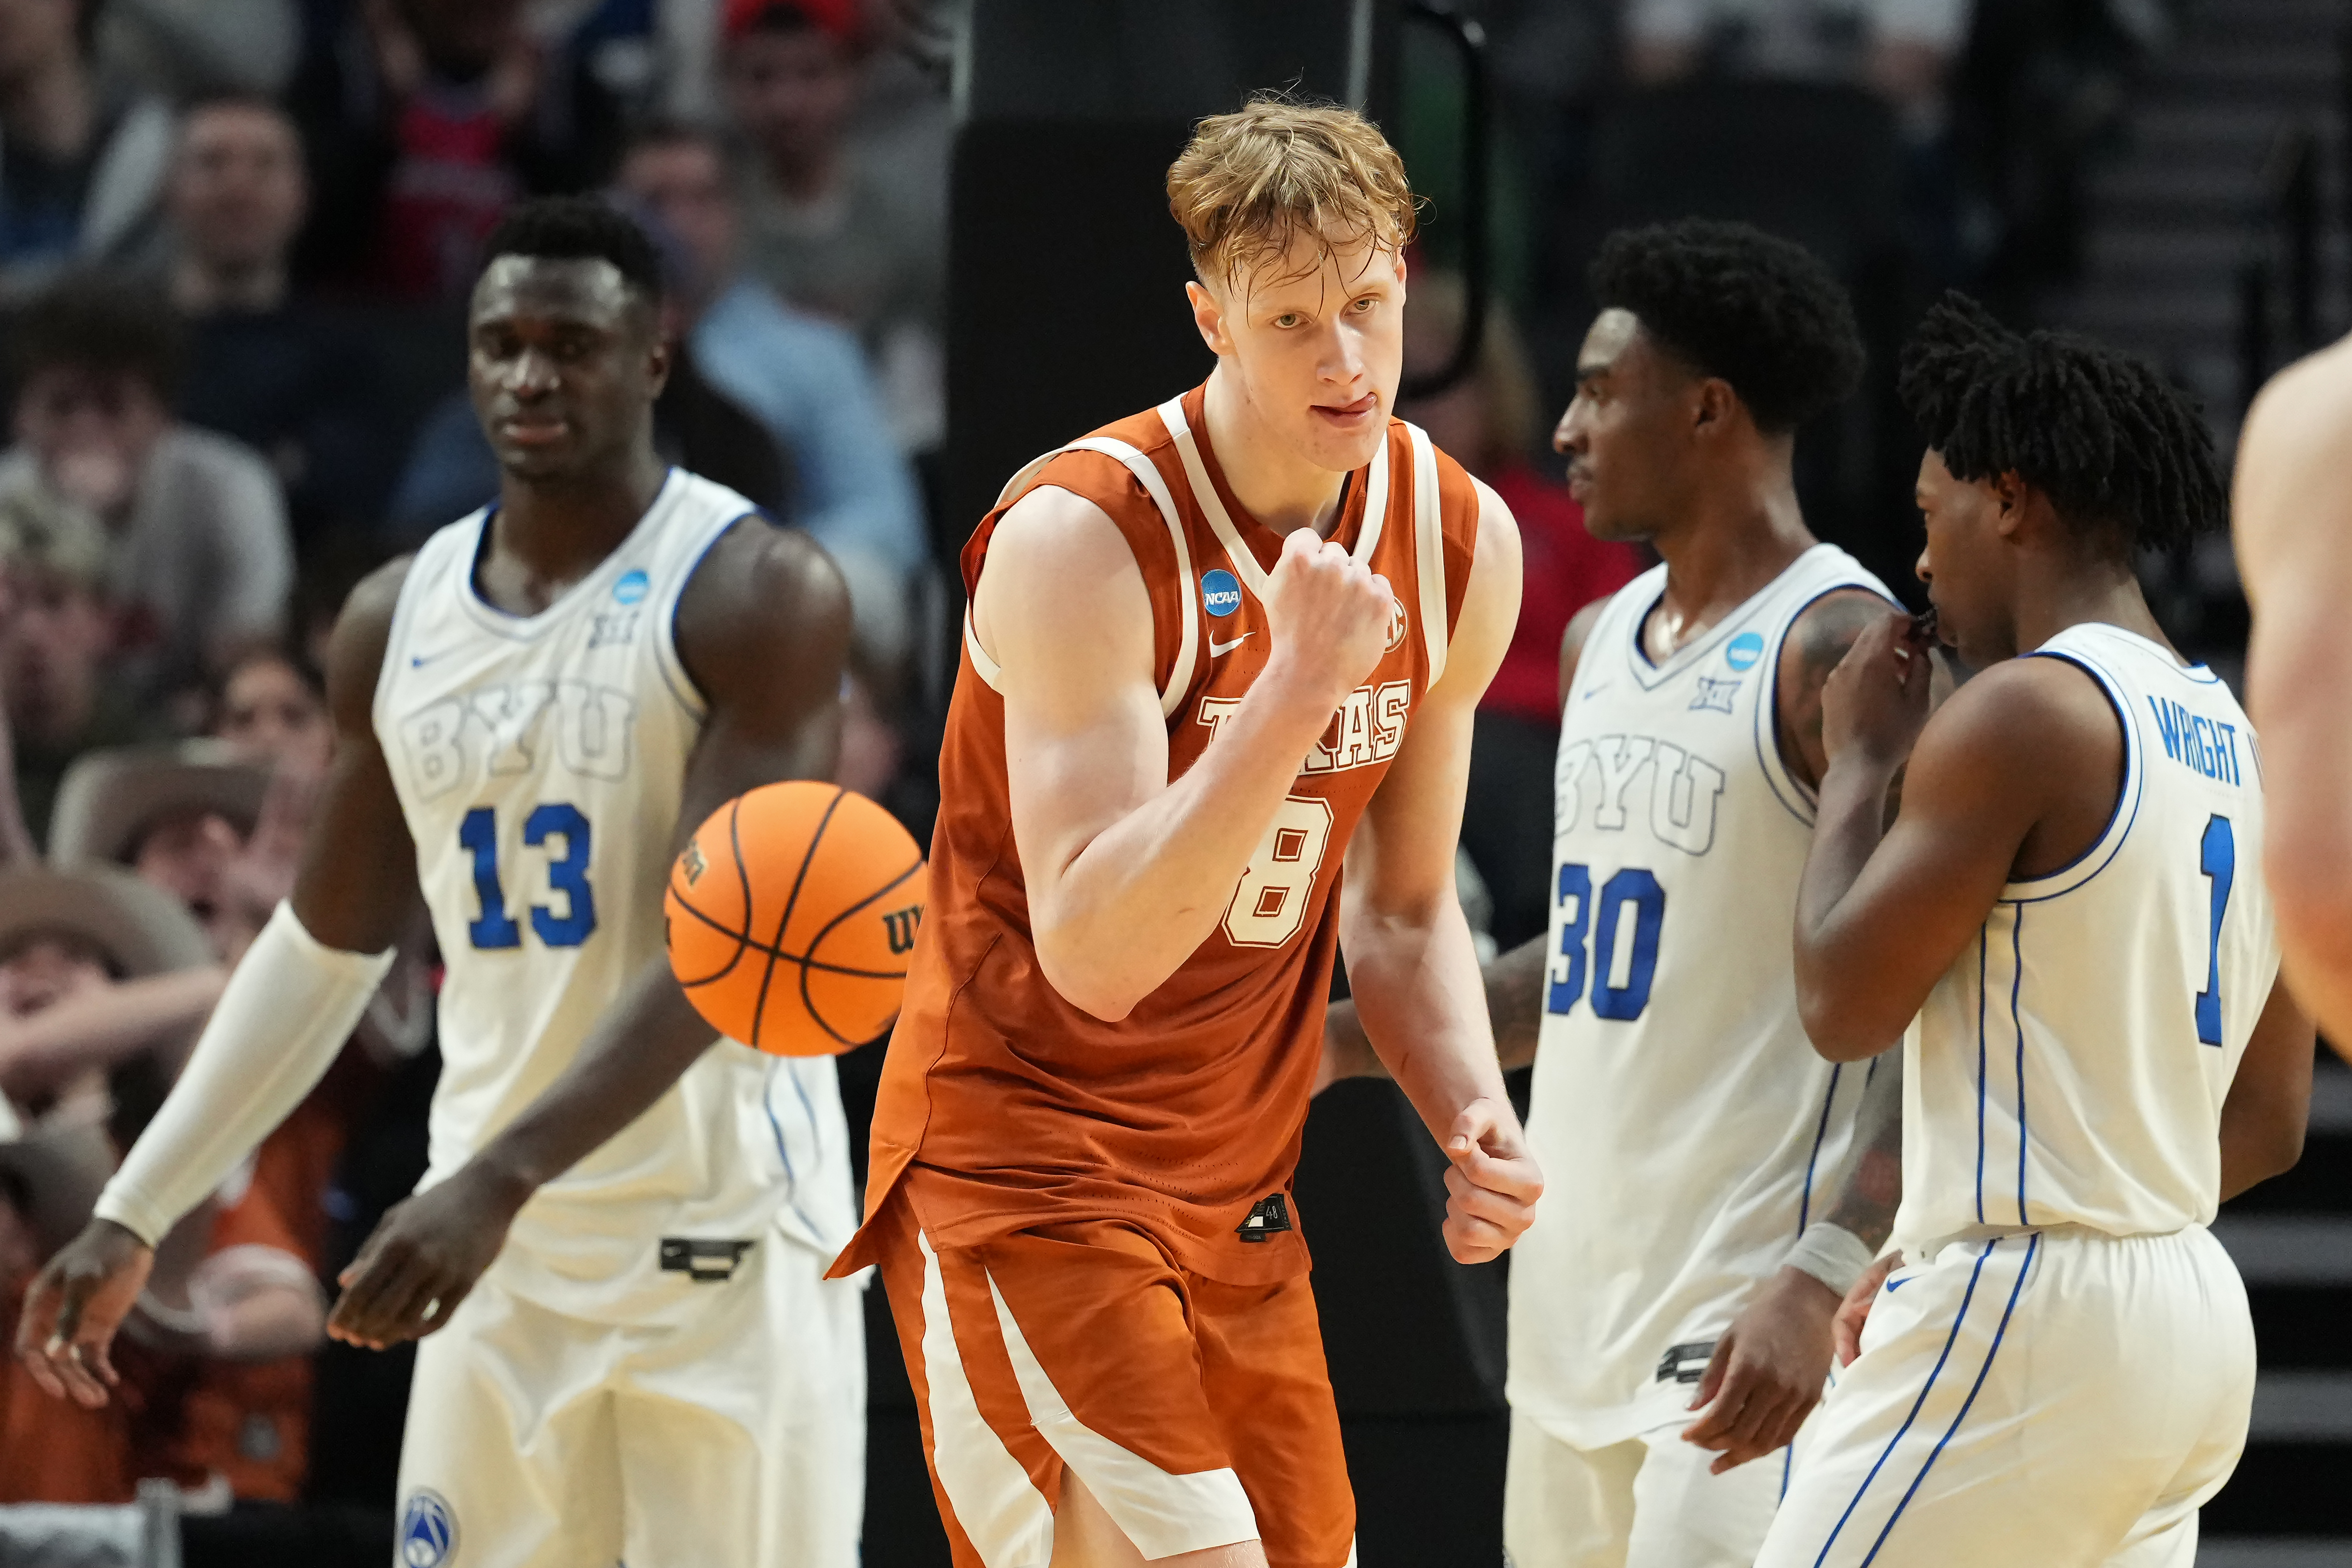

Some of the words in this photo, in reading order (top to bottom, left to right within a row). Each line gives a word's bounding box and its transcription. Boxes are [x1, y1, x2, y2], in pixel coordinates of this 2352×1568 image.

[1205, 591, 1239, 606] NCAA
[399, 680, 637, 805] BYU
[1197, 678, 1411, 777] TAS
[2146, 694, 2240, 787] WRIGHT
[1555, 734, 1725, 857] BYU
[459, 802, 597, 948] 13
[1222, 795, 1334, 949] 8
[2195, 812, 2235, 1048] 1
[1548, 863, 1666, 1021] 30
[1266, 1205, 1278, 1220] 48
